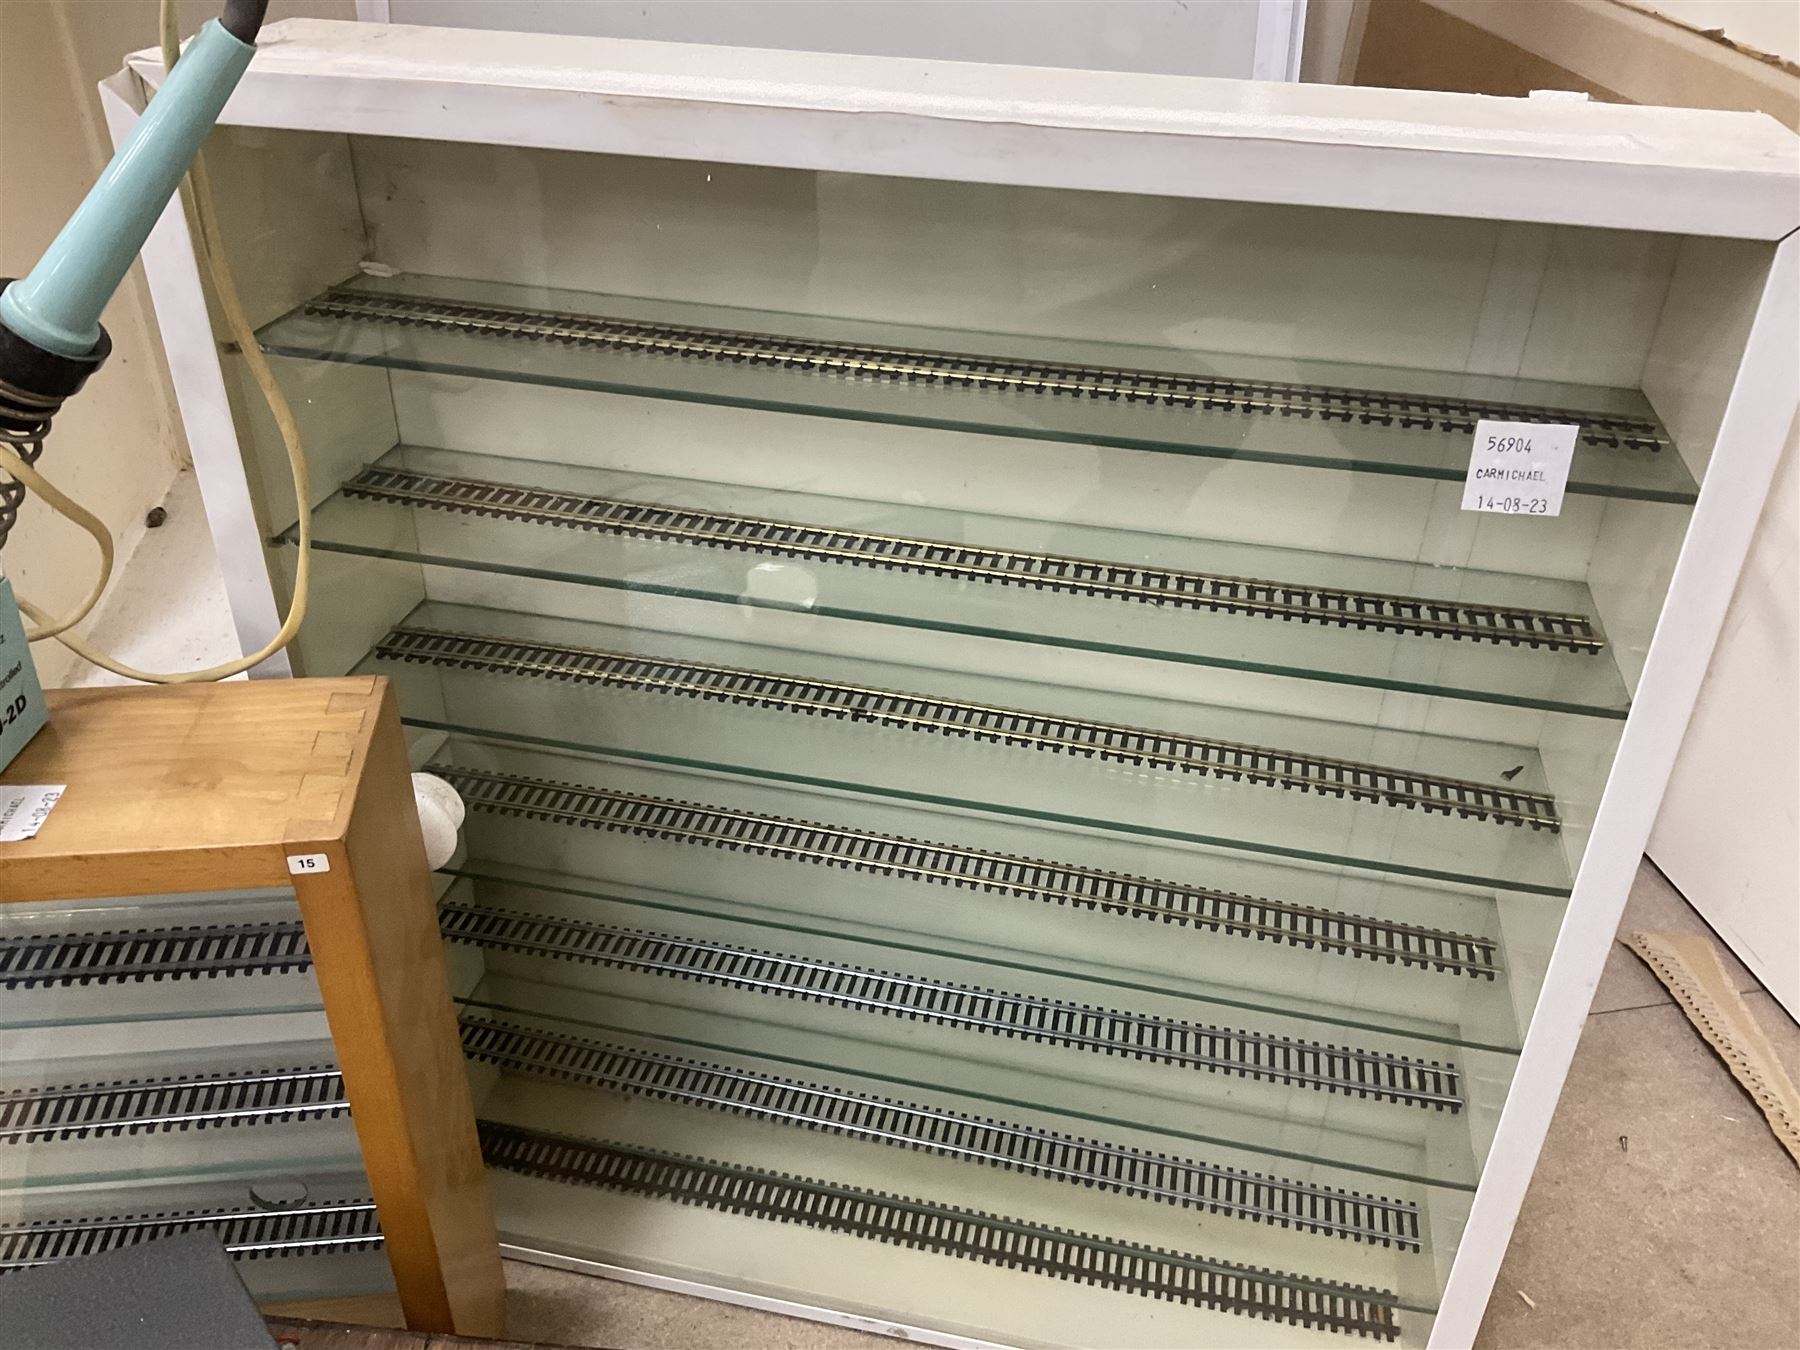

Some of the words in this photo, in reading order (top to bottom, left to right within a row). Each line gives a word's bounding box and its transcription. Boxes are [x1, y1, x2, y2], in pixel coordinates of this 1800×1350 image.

[1487, 436, 1532, 453] 56904
[1475, 467, 1546, 482] CARMICHAEL
[1477, 495, 1548, 514] 14-08-23
[298, 858, 316, 869] 15
